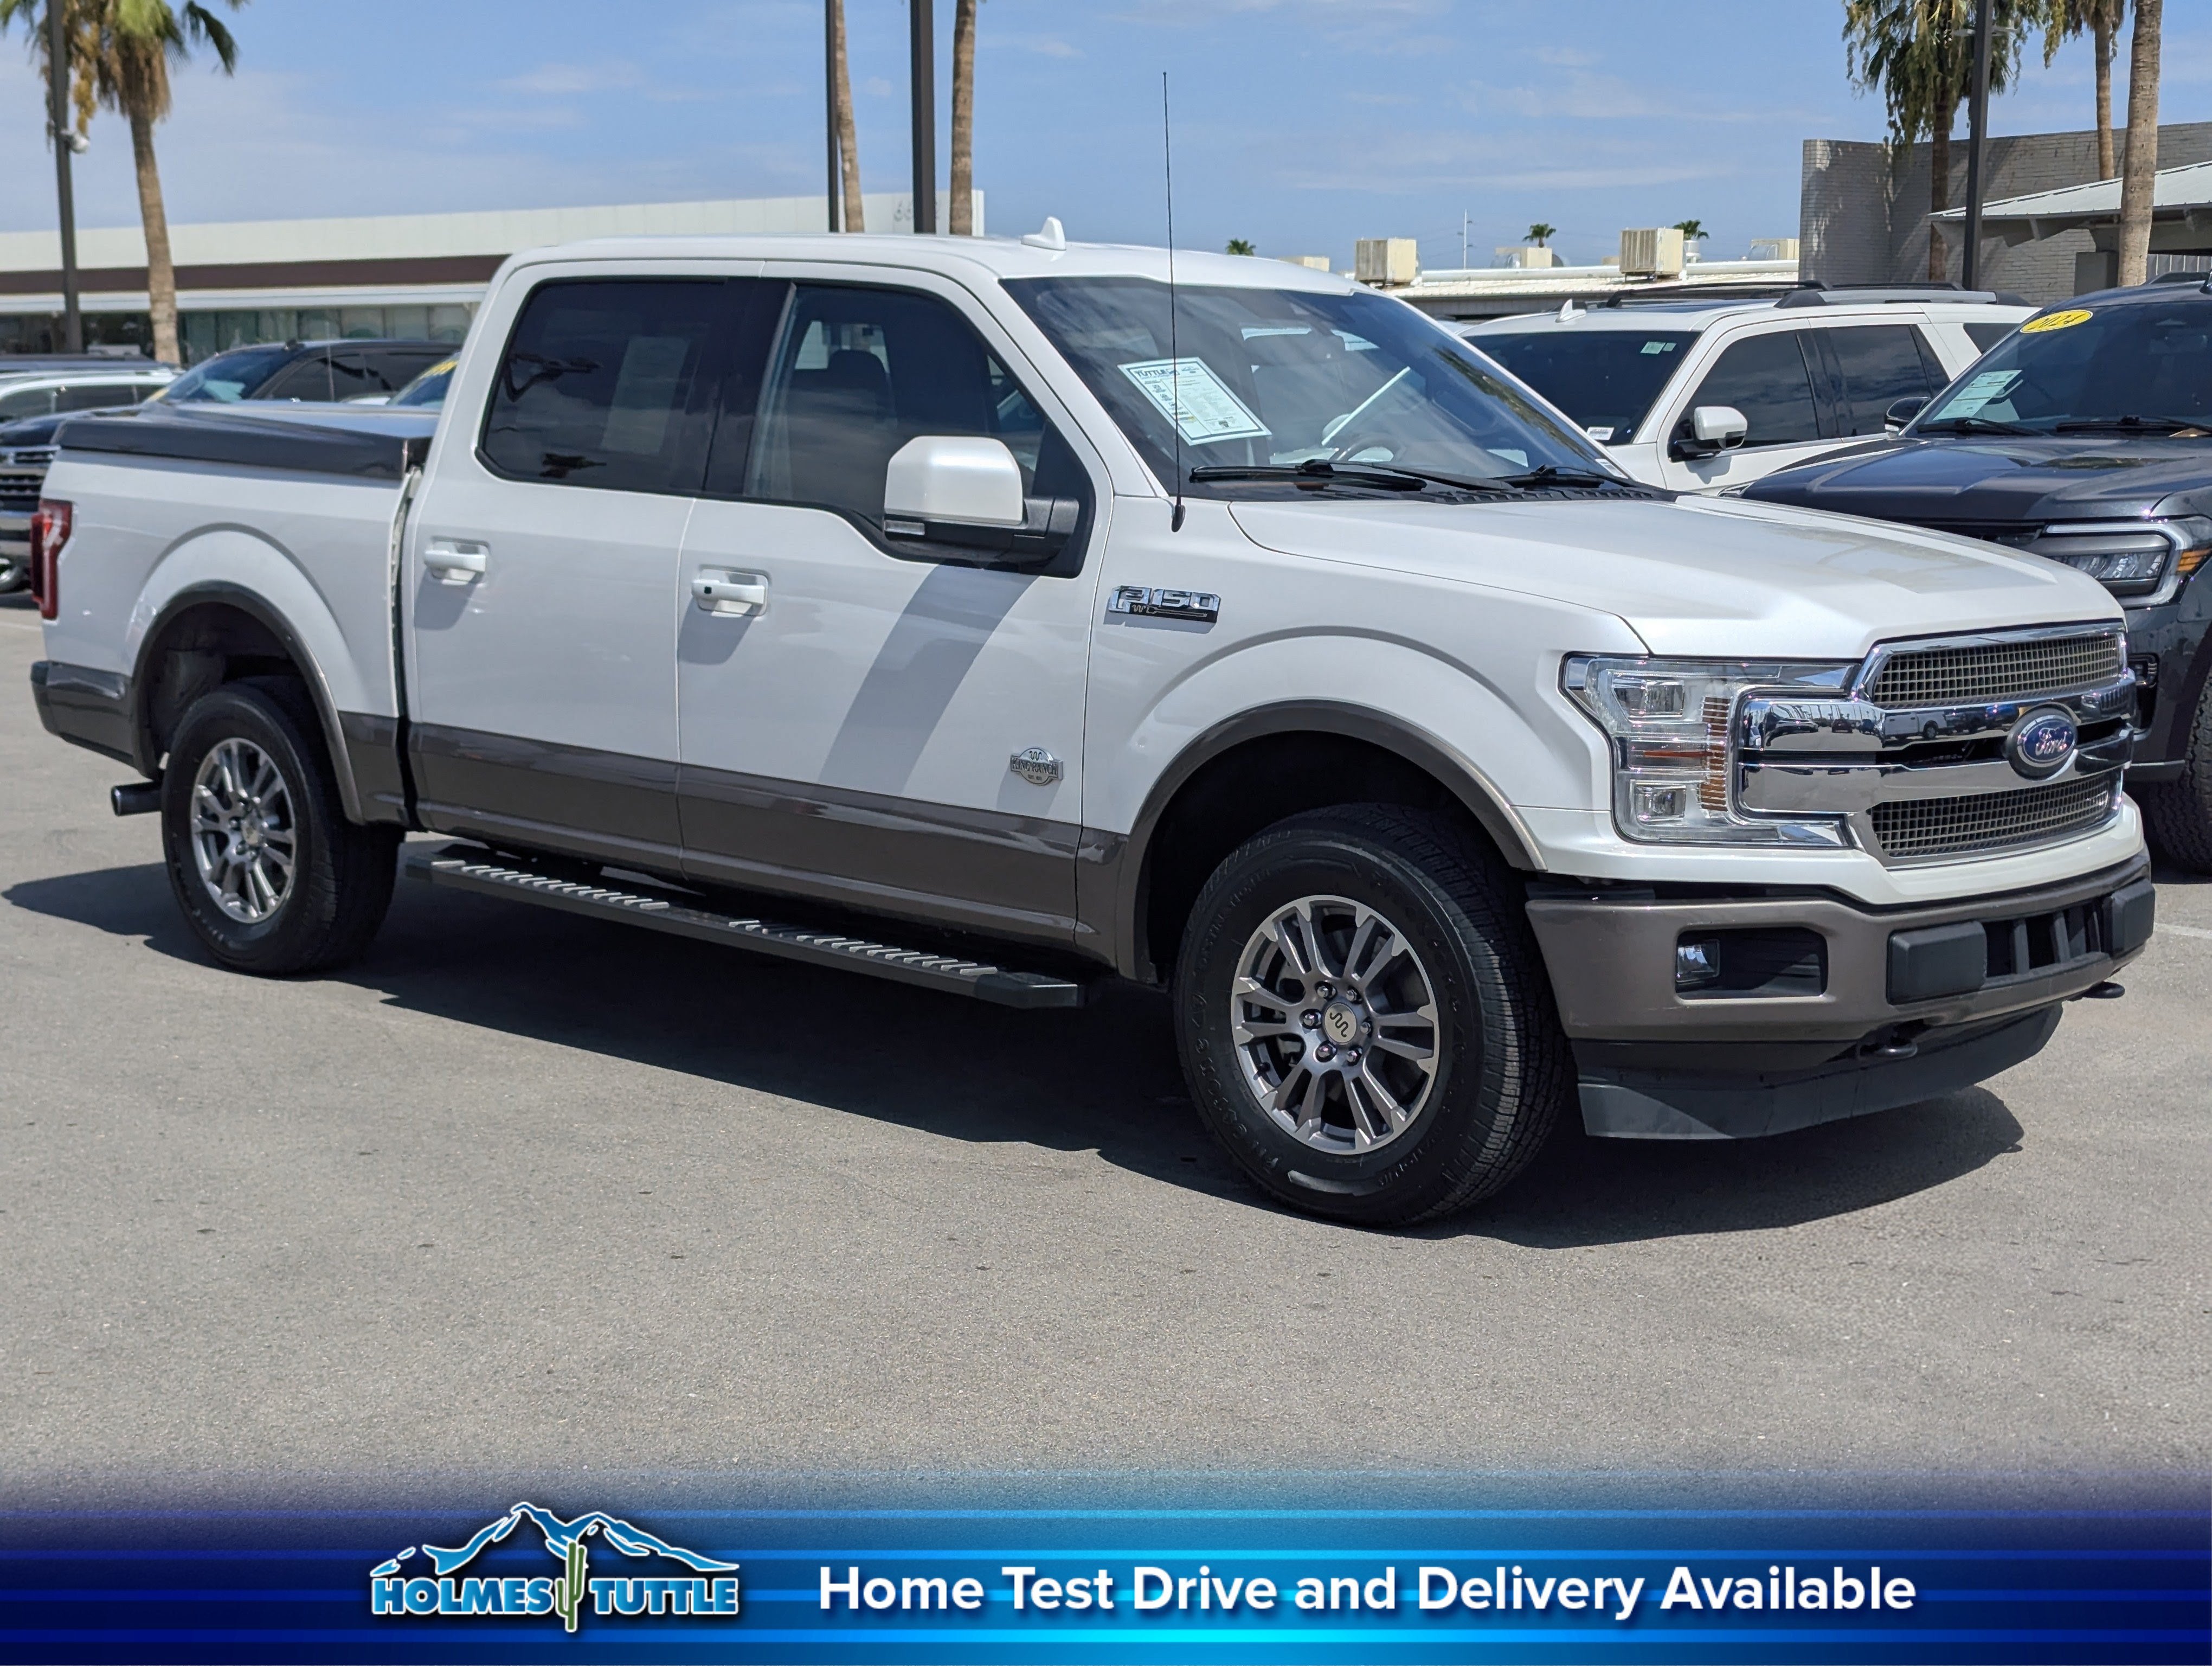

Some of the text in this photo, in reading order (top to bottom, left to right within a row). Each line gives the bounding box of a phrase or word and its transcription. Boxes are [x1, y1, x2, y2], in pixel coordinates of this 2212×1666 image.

[2035, 727, 2067, 755] Ford
[1012, 758, 1057, 775] KING RANCH
